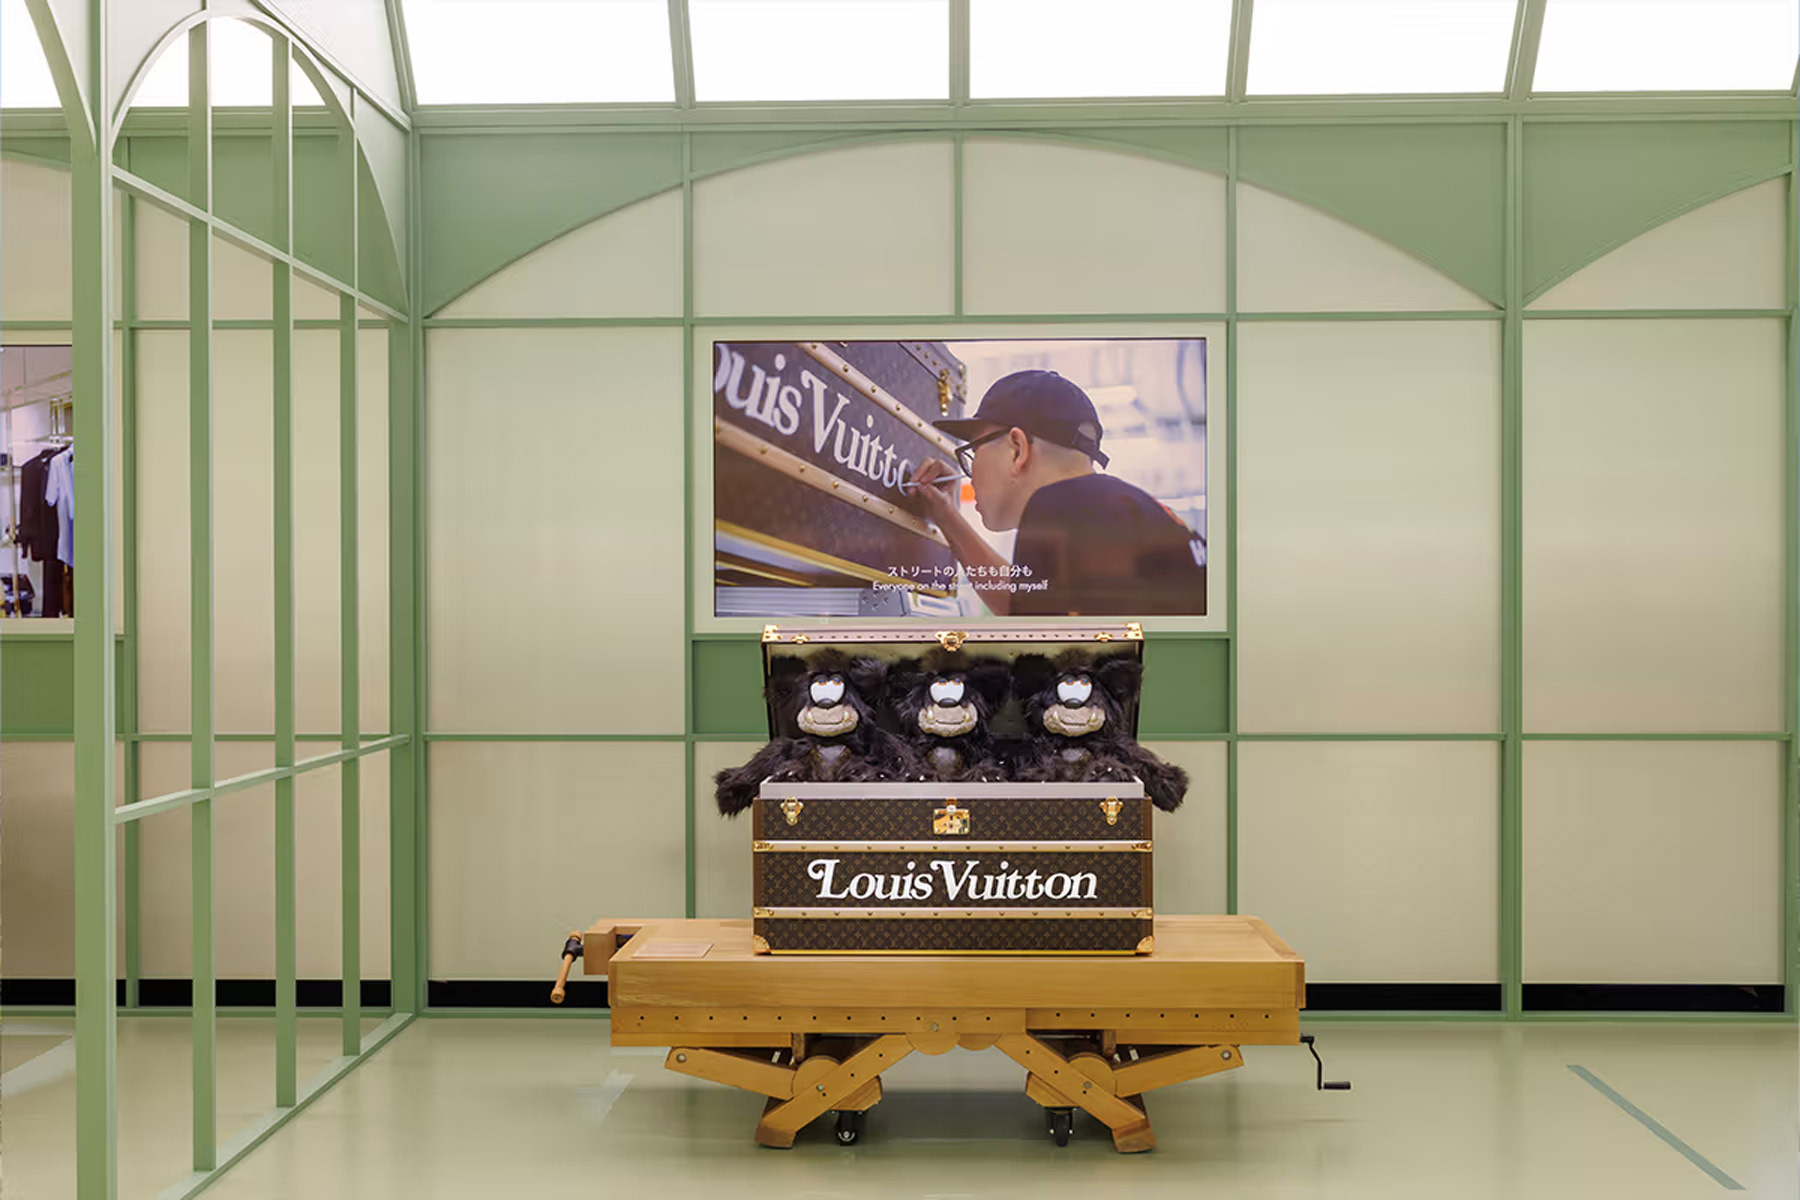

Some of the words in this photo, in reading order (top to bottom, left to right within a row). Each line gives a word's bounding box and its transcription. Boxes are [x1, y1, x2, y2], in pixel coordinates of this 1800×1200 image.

[872, 581, 915, 592] Everyone
[916, 583, 931, 591] on
[931, 580, 947, 591] the
[949, 580, 973, 591] strt
[975, 580, 1017, 593] including
[1018, 579, 1049, 593] myself
[807, 858, 934, 900] Louis
[929, 859, 1098, 901] Vuitton
